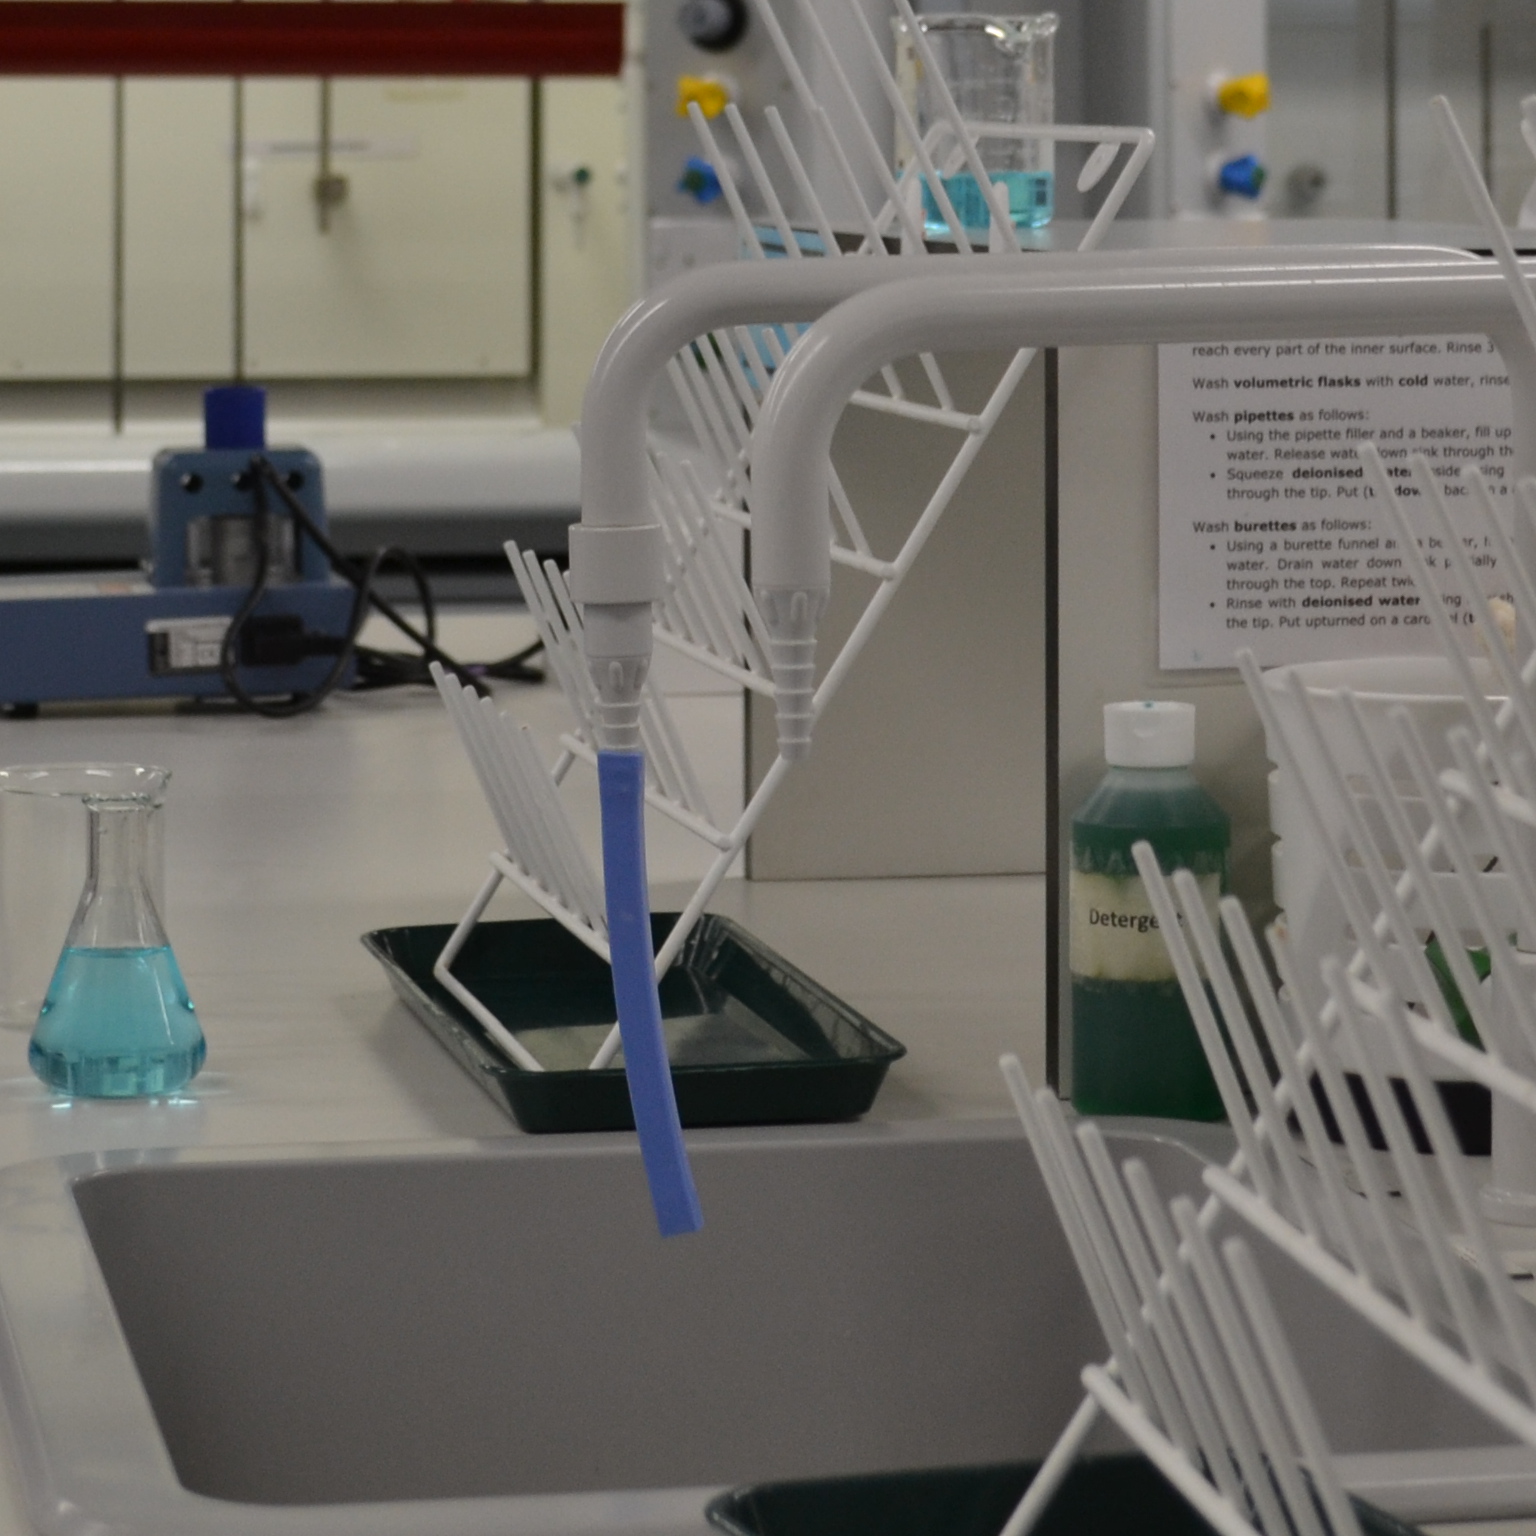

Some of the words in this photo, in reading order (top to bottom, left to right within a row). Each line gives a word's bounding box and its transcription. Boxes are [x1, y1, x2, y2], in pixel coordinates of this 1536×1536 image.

[1192, 344, 1229, 357] reach
[1234, 345, 1271, 358] every
[1276, 344, 1302, 357] part
[1307, 343, 1321, 355] of
[1325, 343, 1346, 355] the
[1351, 342, 1384, 354] inner
[1389, 342, 1441, 354] surface.
[1447, 341, 1482, 353] Rinse
[1192, 377, 1229, 389] Wash
[1234, 376, 1313, 389] volumetric
[1318, 375, 1361, 388] flasks
[1366, 375, 1394, 387] with
[1398, 375, 1429, 387] cold
[1433, 376, 1475, 389] water,
[1192, 410, 1229, 423] Wash
[1234, 410, 1295, 424] pipettes
[1299, 411, 1314, 421] as
[1318, 408, 1369, 421] follows:
[1226, 429, 1263, 443] Using
[1269, 428, 1290, 441] the
[1295, 428, 1341, 443] pipette
[1346, 427, 1375, 440] filler
[1379, 427, 1404, 439] and
[1409, 428, 1416, 439] a
[1421, 426, 1470, 441] beaker,
[1475, 425, 1490, 438] fill
[1495, 427, 1512, 441] up
[1226, 448, 1269, 460] water.
[1274, 447, 1326, 460] Release
[1330, 447, 1358, 460] wat
[1443, 444, 1495, 460] through
[1499, 444, 1513, 457] th
[1226, 468, 1284, 482] Squeeze
[1292, 466, 1363, 479] deionised
[1226, 487, 1279, 501] through
[1284, 486, 1306, 499] the
[1310, 486, 1332, 501] tip.
[1336, 485, 1359, 498] Put
[1192, 520, 1229, 534] Wash
[1234, 520, 1297, 533] burettes
[1301, 521, 1316, 531] as
[1321, 518, 1372, 531] follows:
[1226, 539, 1264, 554] Using
[1269, 541, 1278, 551] a
[1284, 538, 1332, 551] burette
[1337, 537, 1379, 550] funnel
[1226, 559, 1269, 571] water.
[1277, 557, 1313, 570] Drain
[1321, 557, 1360, 570] water
[1367, 555, 1402, 569] down
[1226, 578, 1279, 592] through
[1283, 577, 1305, 590] the
[1309, 576, 1336, 591] top.
[1340, 575, 1387, 590] Repeat
[1226, 596, 1263, 610] Rinse
[1268, 596, 1296, 609] with
[1301, 594, 1373, 609] deionised
[1378, 595, 1421, 607] water
[1226, 617, 1248, 629] the
[1252, 616, 1274, 631] tip.
[1279, 615, 1301, 628] Put
[1305, 615, 1366, 630] upturned
[1370, 615, 1386, 626] on
[1390, 615, 1399, 626] a
[1089, 908, 1182, 933] Deterge
